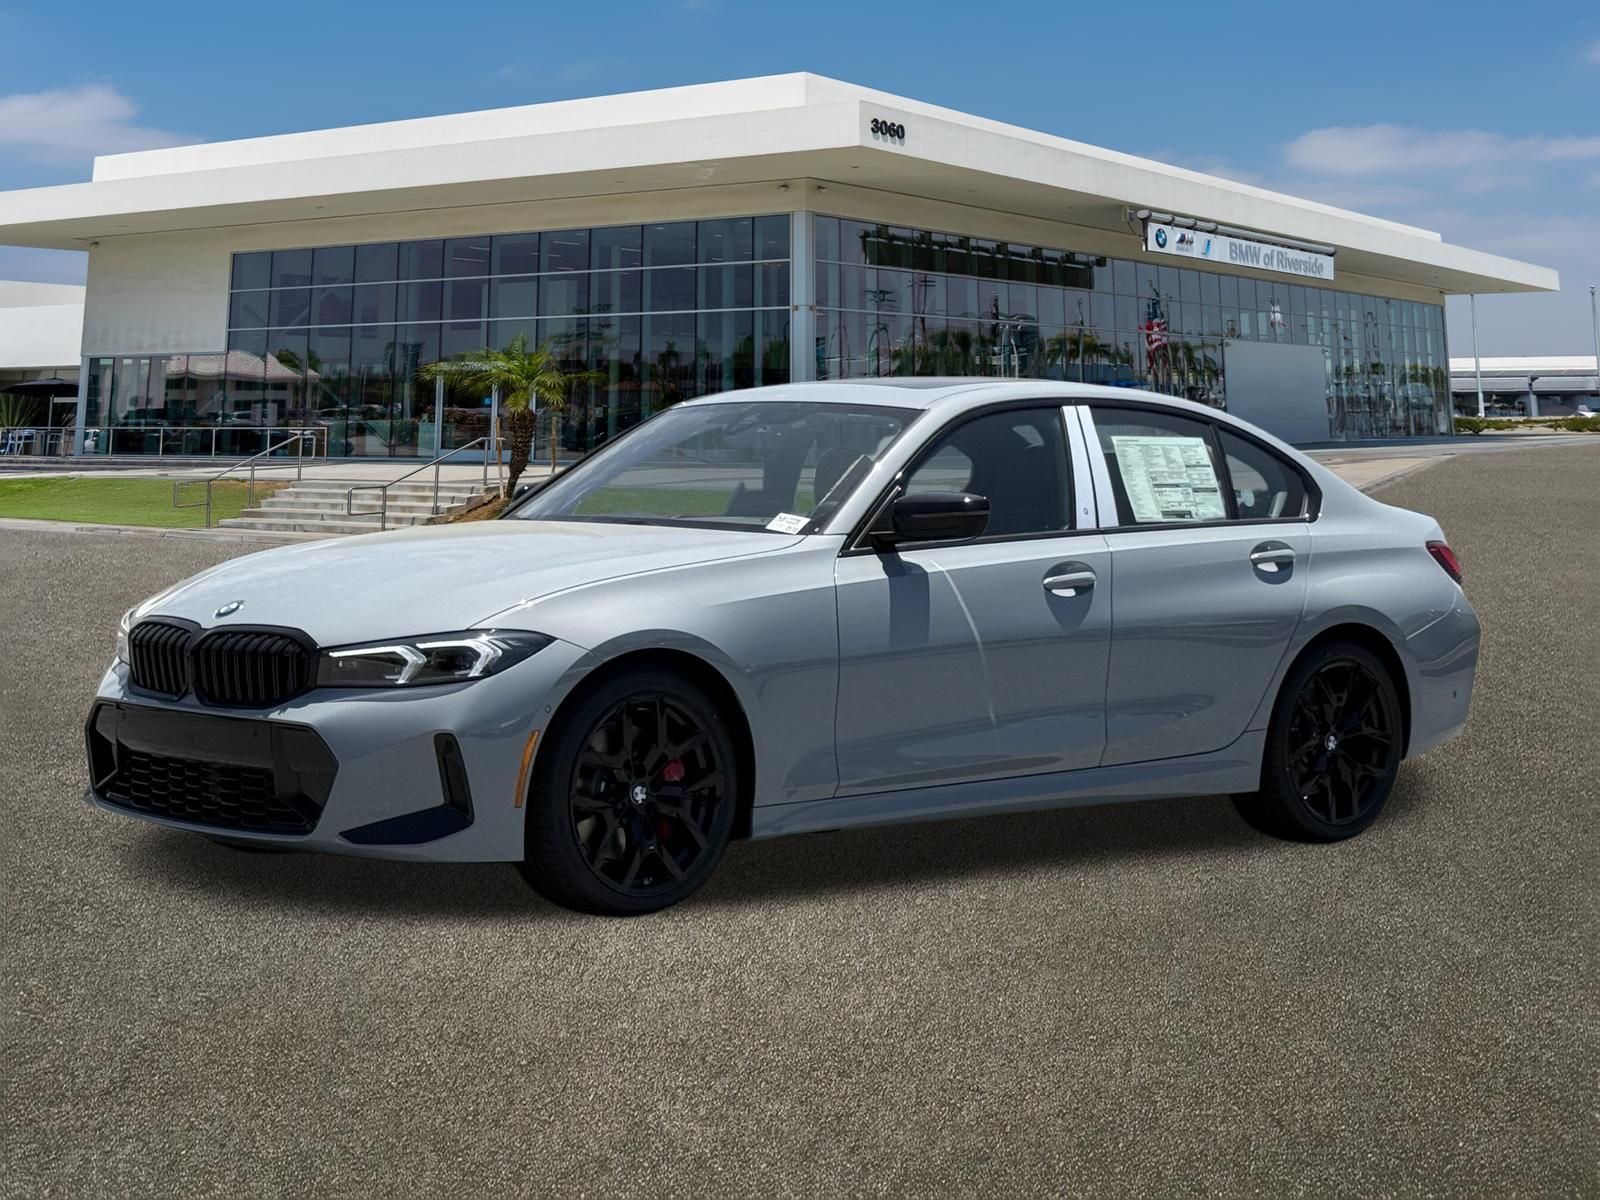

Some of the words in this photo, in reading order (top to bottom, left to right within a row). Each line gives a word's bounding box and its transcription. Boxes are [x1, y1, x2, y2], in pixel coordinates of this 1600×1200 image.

[870, 118, 905, 140] 3060
[1229, 242, 1261, 265] BMW
[1263, 249, 1275, 267] of
[1277, 250, 1324, 276] Riverside
